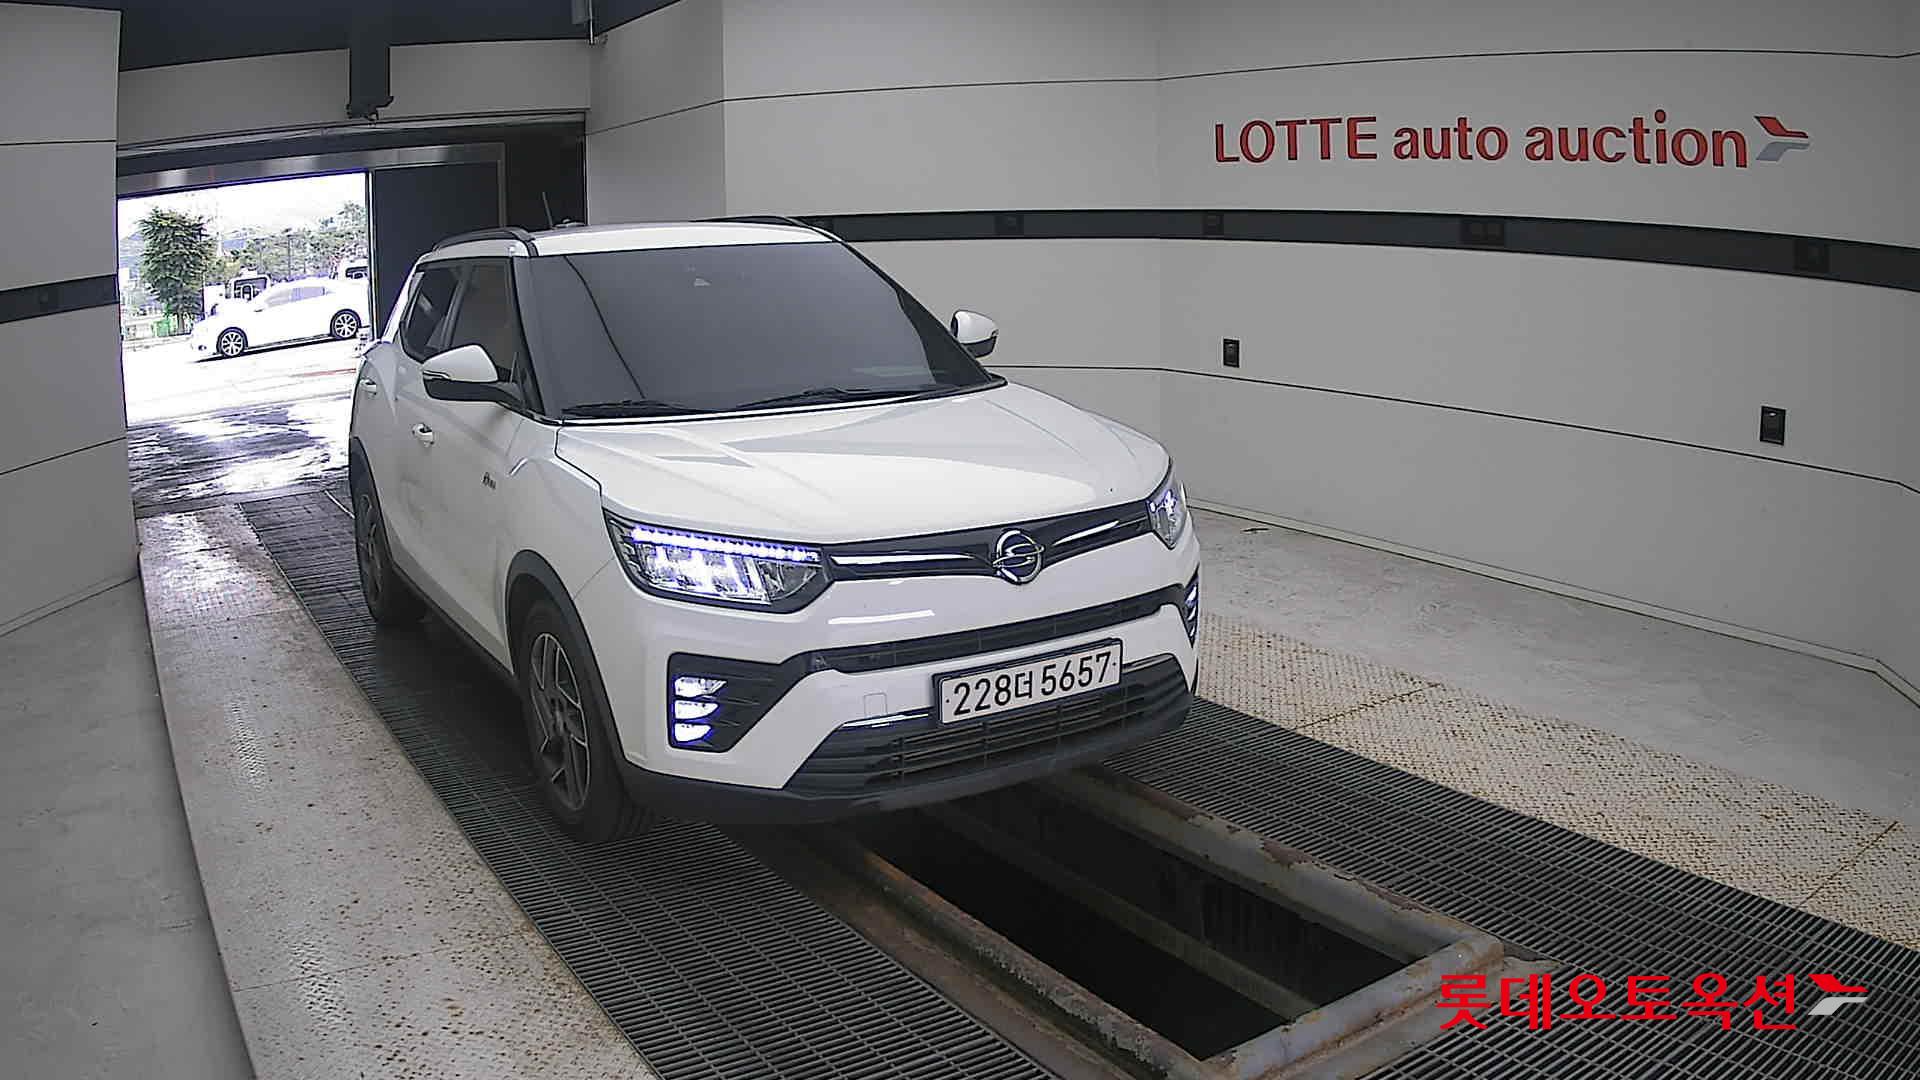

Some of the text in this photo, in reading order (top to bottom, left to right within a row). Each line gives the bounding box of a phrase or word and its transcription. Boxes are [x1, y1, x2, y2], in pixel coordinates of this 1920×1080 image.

[1214, 109, 1749, 168] LOTTE auto auction
[953, 651, 1111, 716] 228더 5657
